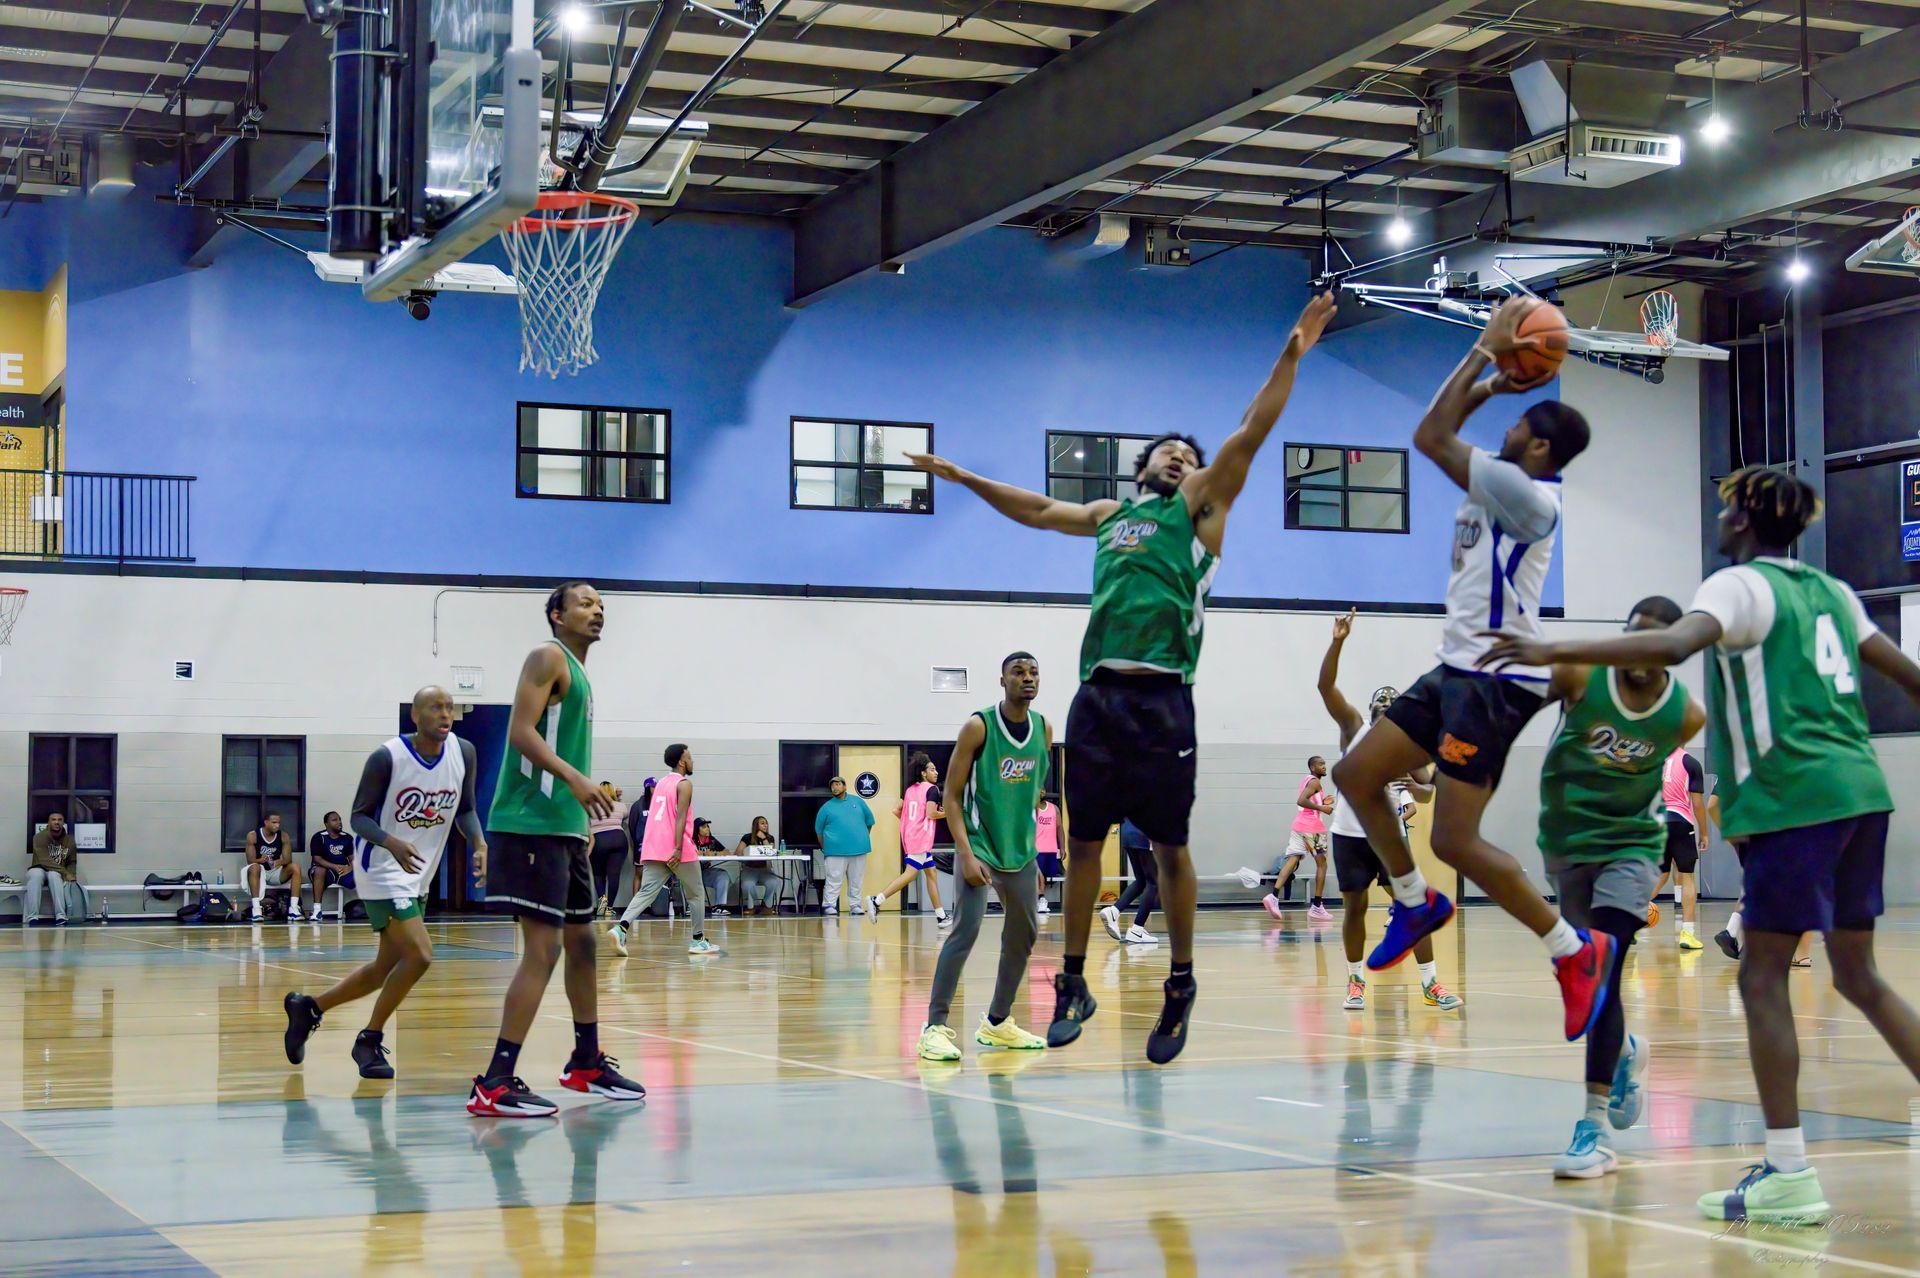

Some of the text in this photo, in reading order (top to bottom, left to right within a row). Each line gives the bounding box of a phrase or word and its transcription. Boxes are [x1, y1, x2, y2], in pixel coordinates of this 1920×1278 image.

[1816, 612, 1856, 694] 4
[655, 795, 666, 821] 7
[909, 801, 919, 821] 0
